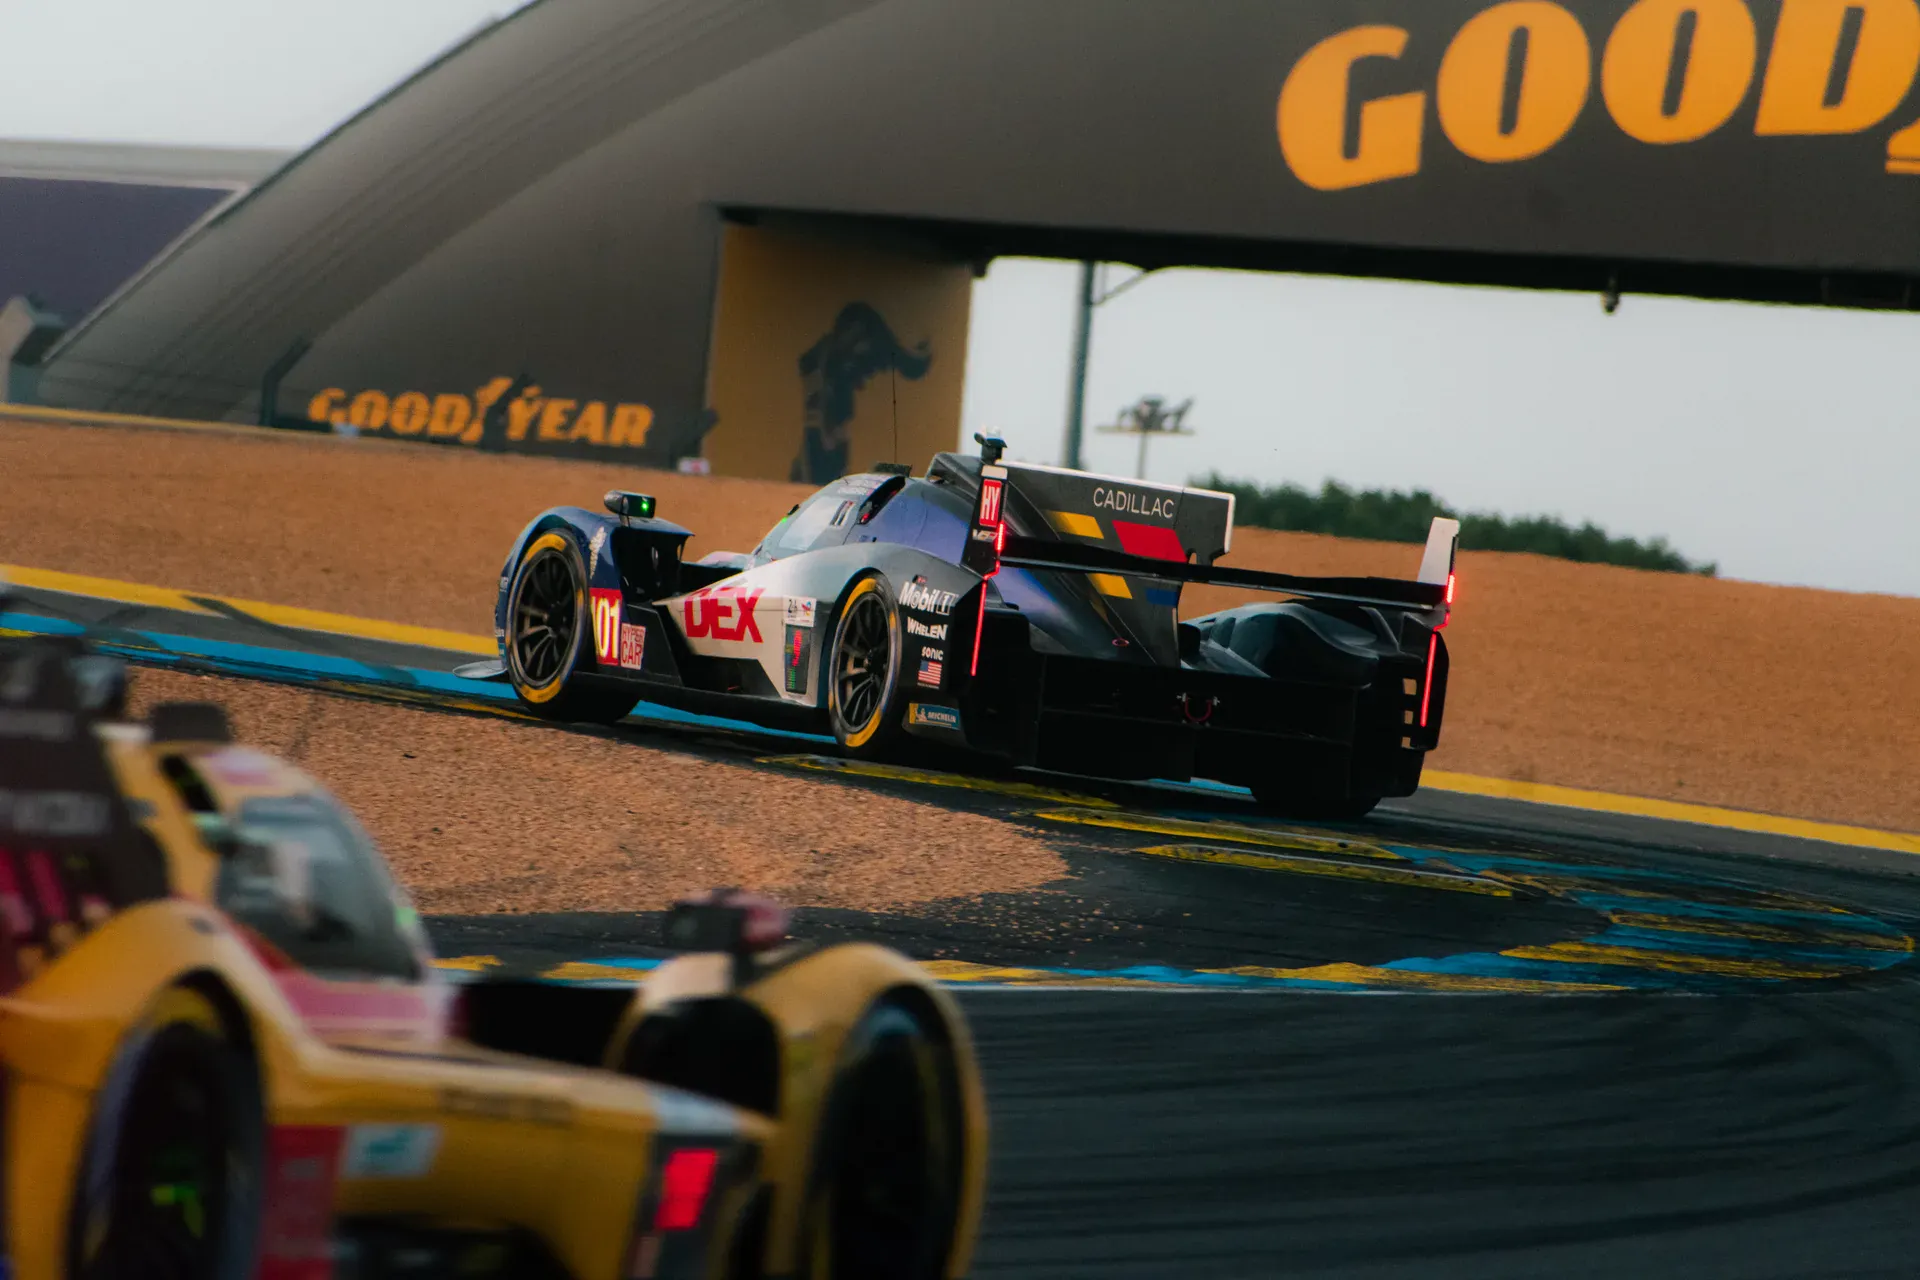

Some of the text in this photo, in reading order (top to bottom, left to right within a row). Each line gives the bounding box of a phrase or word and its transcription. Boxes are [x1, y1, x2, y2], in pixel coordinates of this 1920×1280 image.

[981, 485, 1001, 521] HY
[1093, 487, 1175, 519] CADILLAC
[899, 581, 941, 613] Mobil
[684, 586, 765, 644] DEX
[907, 616, 948, 641] WHELEN
[621, 640, 643, 667] CAR
[927, 711, 957, 724] MICHELIN
